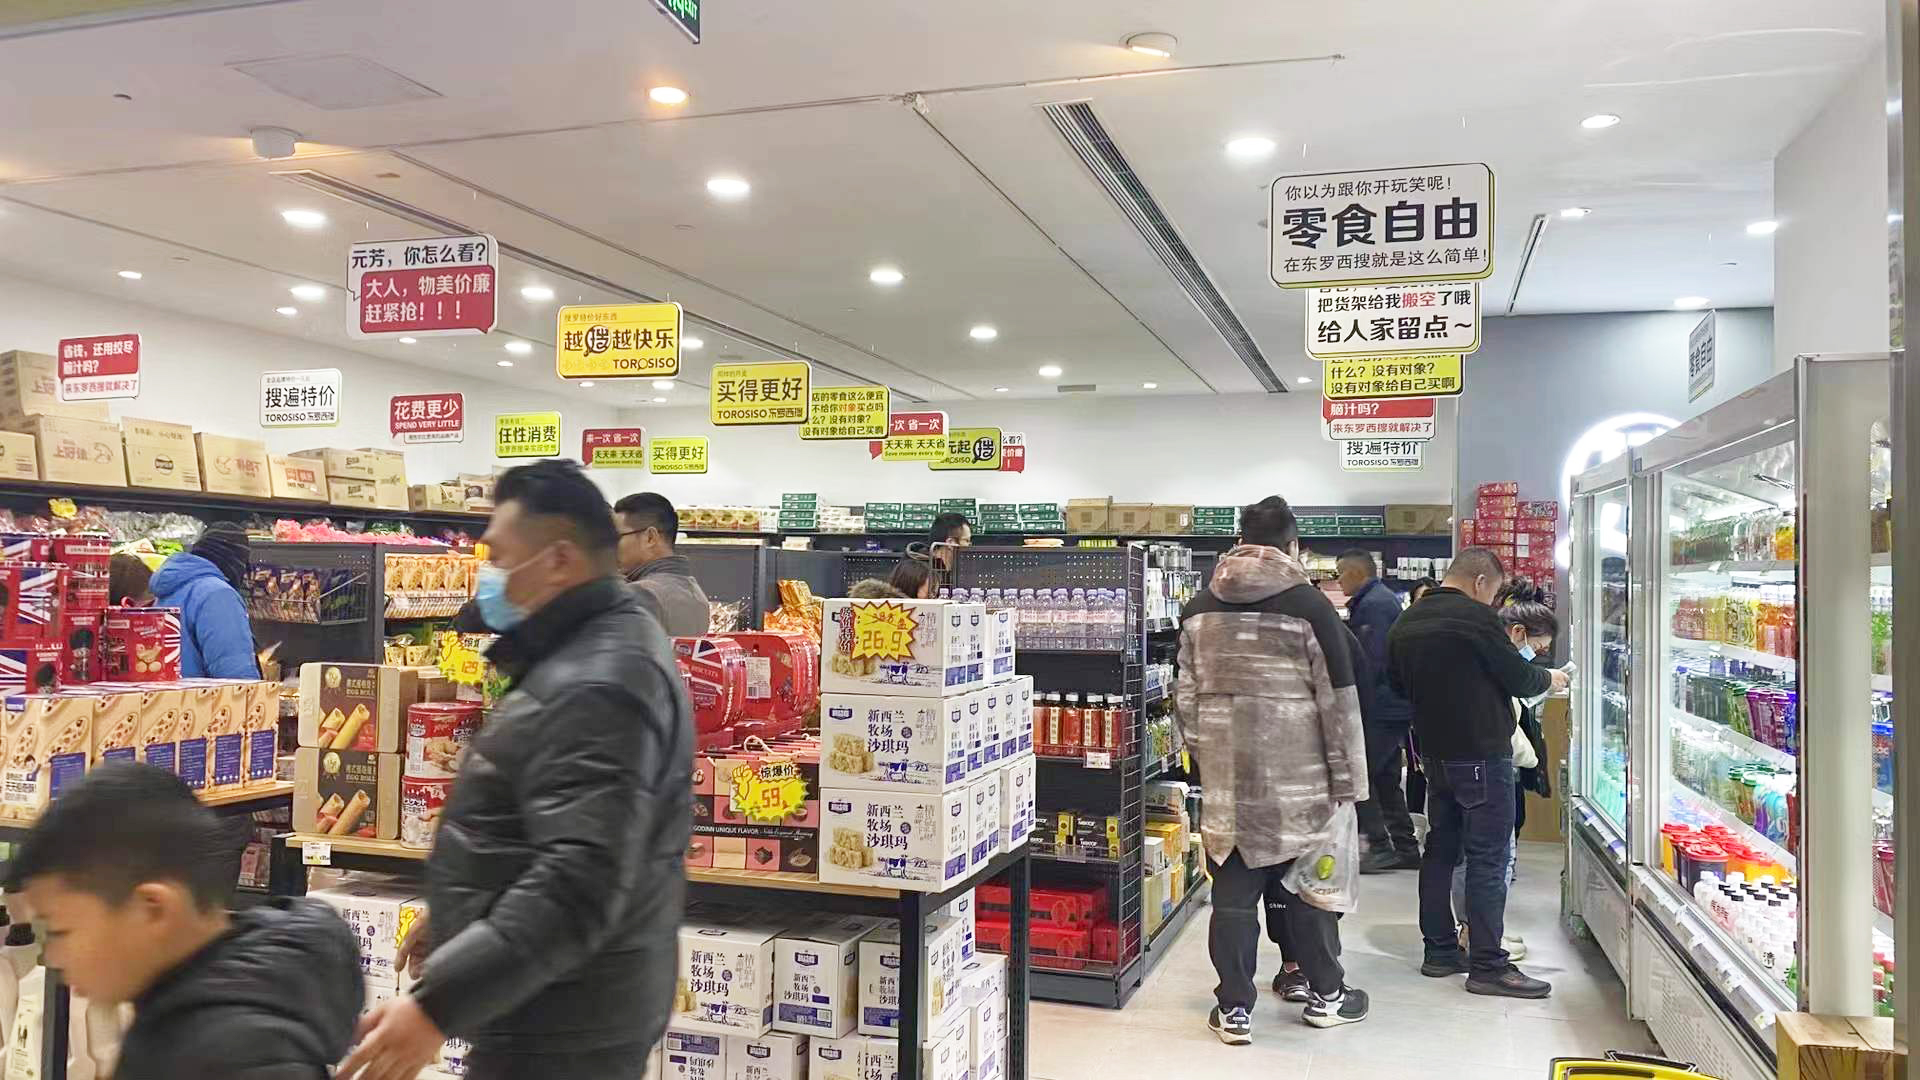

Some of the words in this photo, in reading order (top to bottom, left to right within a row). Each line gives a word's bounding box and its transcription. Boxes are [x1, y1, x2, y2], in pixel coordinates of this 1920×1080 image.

[1285, 175, 1452, 201] 你以为跟你开玩笑呢！
[1282, 196, 1478, 250] 零食自由
[352, 243, 486, 269] 元芳，你怎么看？
[1283, 246, 1488, 273] 在东罗西搜就是这么简单！
[365, 273, 491, 299] 大人，物美价廉
[1317, 289, 1472, 313] 把货架给我搬空了哦
[364, 300, 460, 324] 赶紧抢！！！
[613, 357, 676, 371] TOROSISO
[1330, 362, 1435, 380] 什么？没有对象？
[717, 378, 802, 403] 买得更好
[1330, 376, 1455, 395] 没有对象给自己买啊
[265, 385, 335, 408] 搜遍特价
[265, 413, 306, 422] TOROSISO
[394, 398, 459, 421] 花费更少
[717, 409, 768, 419] TOROSISO
[1330, 403, 1380, 417] 脑汁吗？
[395, 421, 417, 430] SPEND
[417, 420, 437, 429] VERY
[437, 419, 460, 428] LITTLE
[802, 425, 884, 437] 没有对象给自己买啊
[908, 418, 940, 431] 省一次
[1332, 421, 1432, 434] 来东罗西搜就解决了
[499, 425, 556, 444] 任性消费
[885, 440, 913, 450] 天天来
[916, 438, 945, 449] 天天省
[1346, 441, 1418, 456] 搜遍特价
[652, 446, 704, 460] 买得更好
[1347, 459, 1389, 467] TOROSISO
[862, 630, 902, 652] 26.9
[867, 708, 906, 724] 新西兰
[867, 724, 893, 738] 牧场
[867, 738, 910, 755] 沙琪玛
[760, 764, 794, 779] 惊爆价
[866, 803, 904, 819] 新西兰
[738, 826, 759, 835] FLAVOR
[866, 818, 892, 833] 牧场
[866, 833, 908, 851] 沙琪玛
[690, 950, 726, 966] 新西兰
[690, 965, 714, 979] 牧场
[690, 979, 729, 997] 沙琪玛
[783, 990, 810, 1003] 沙琪玛
